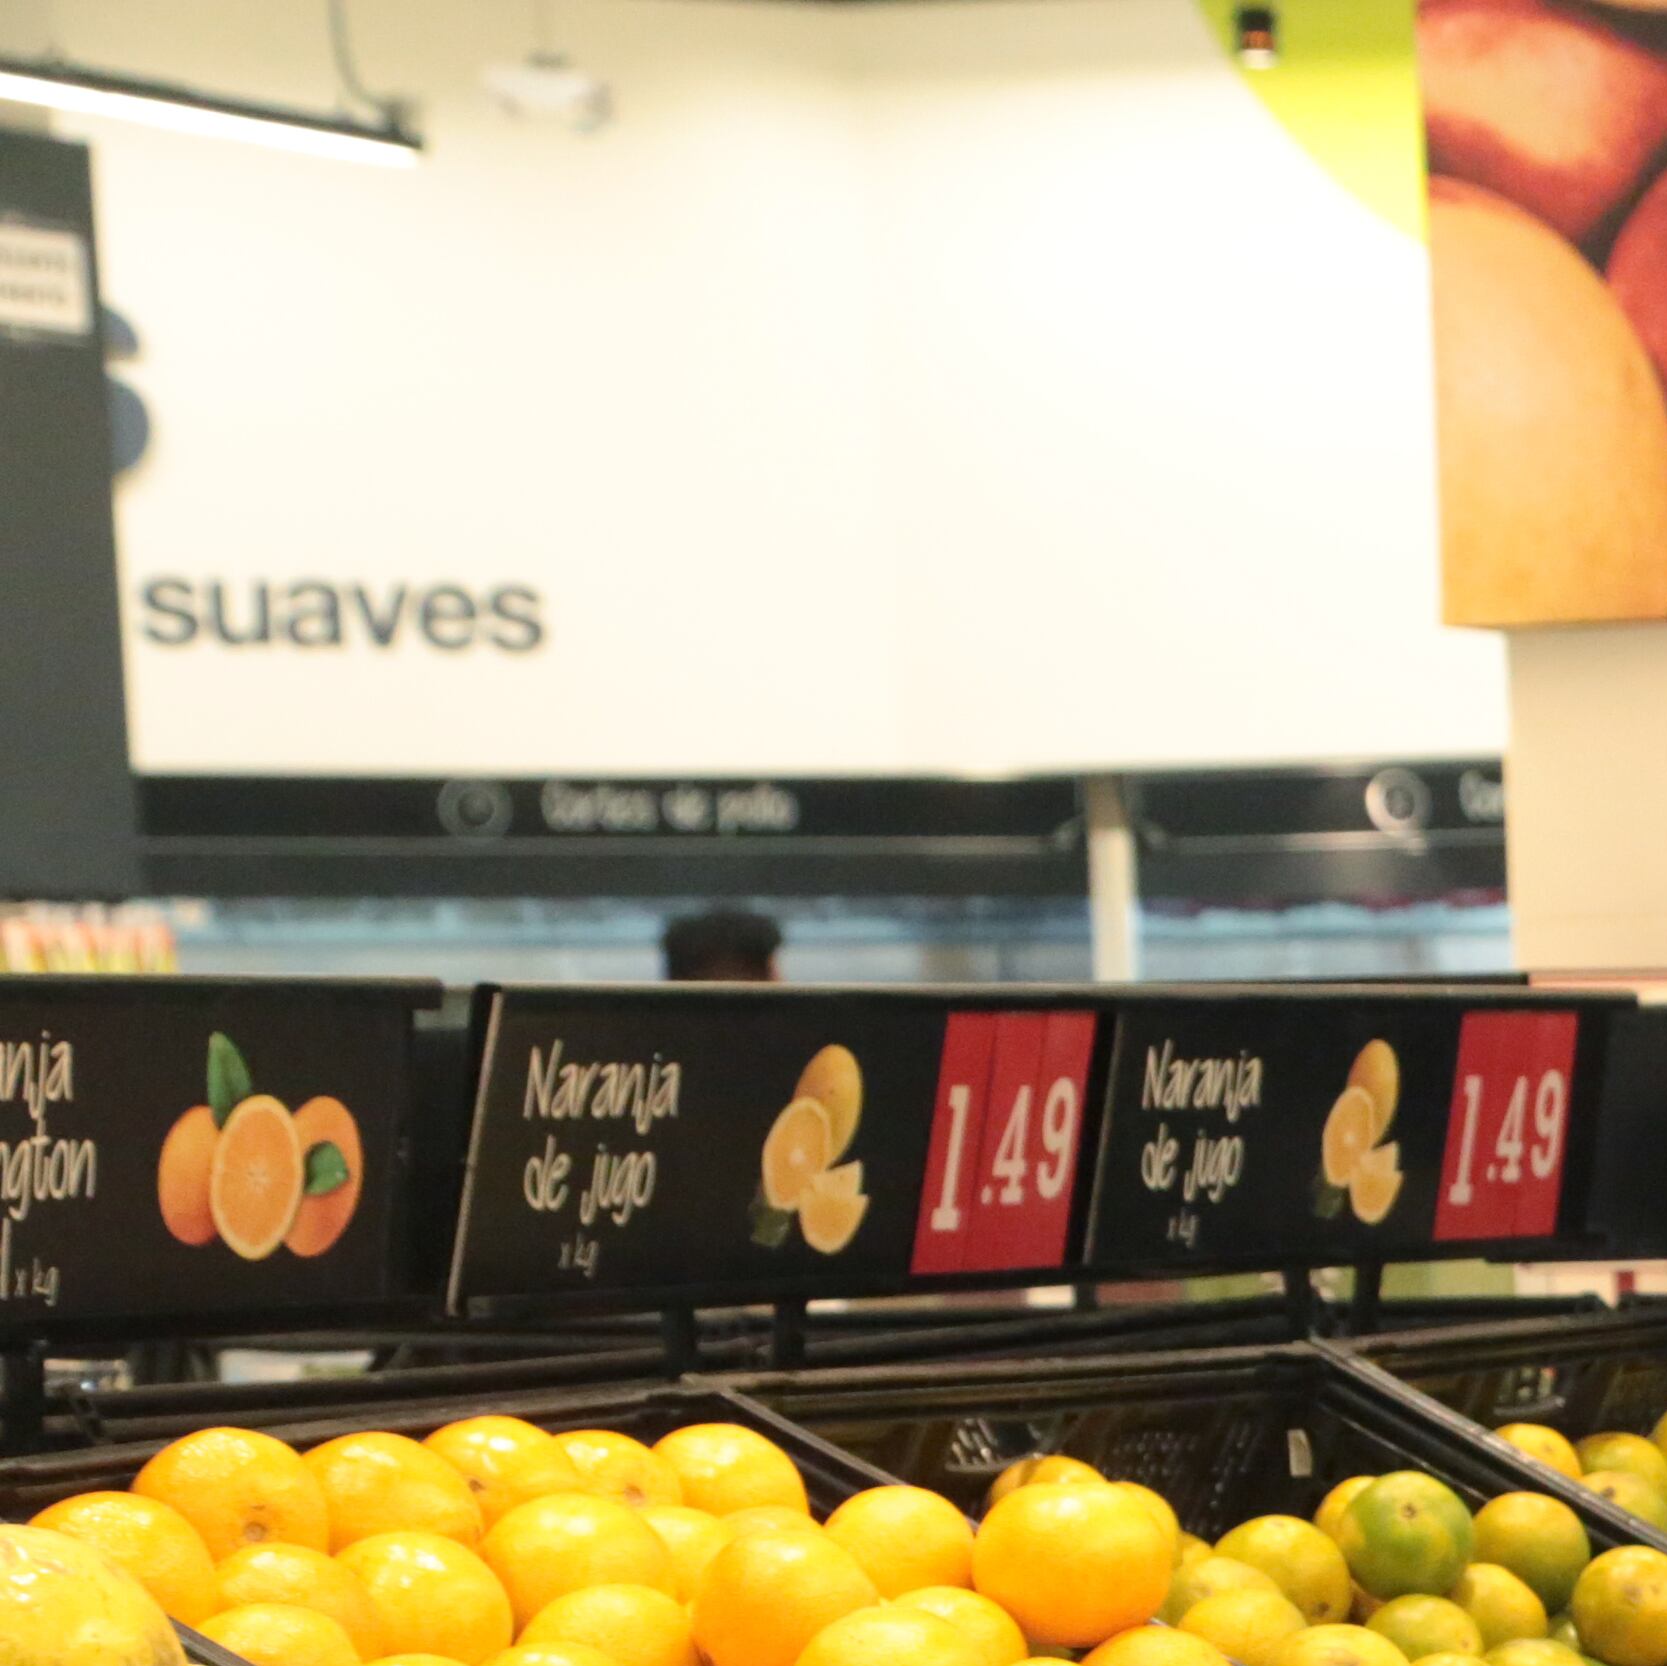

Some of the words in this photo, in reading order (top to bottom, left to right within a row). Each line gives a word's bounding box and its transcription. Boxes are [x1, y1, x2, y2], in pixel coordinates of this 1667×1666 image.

[141, 576, 545, 651] suaves
[523, 1038, 681, 1135] Naranja
[1142, 1037, 1263, 1123] Naranja
[524, 1134, 572, 1211] de
[580, 1143, 656, 1227] jugo
[930, 1076, 1077, 1231] 1.49
[1141, 1122, 1179, 1191] de
[1183, 1129, 1244, 1202] jugo
[1448, 1068, 1566, 1206] 1.49
